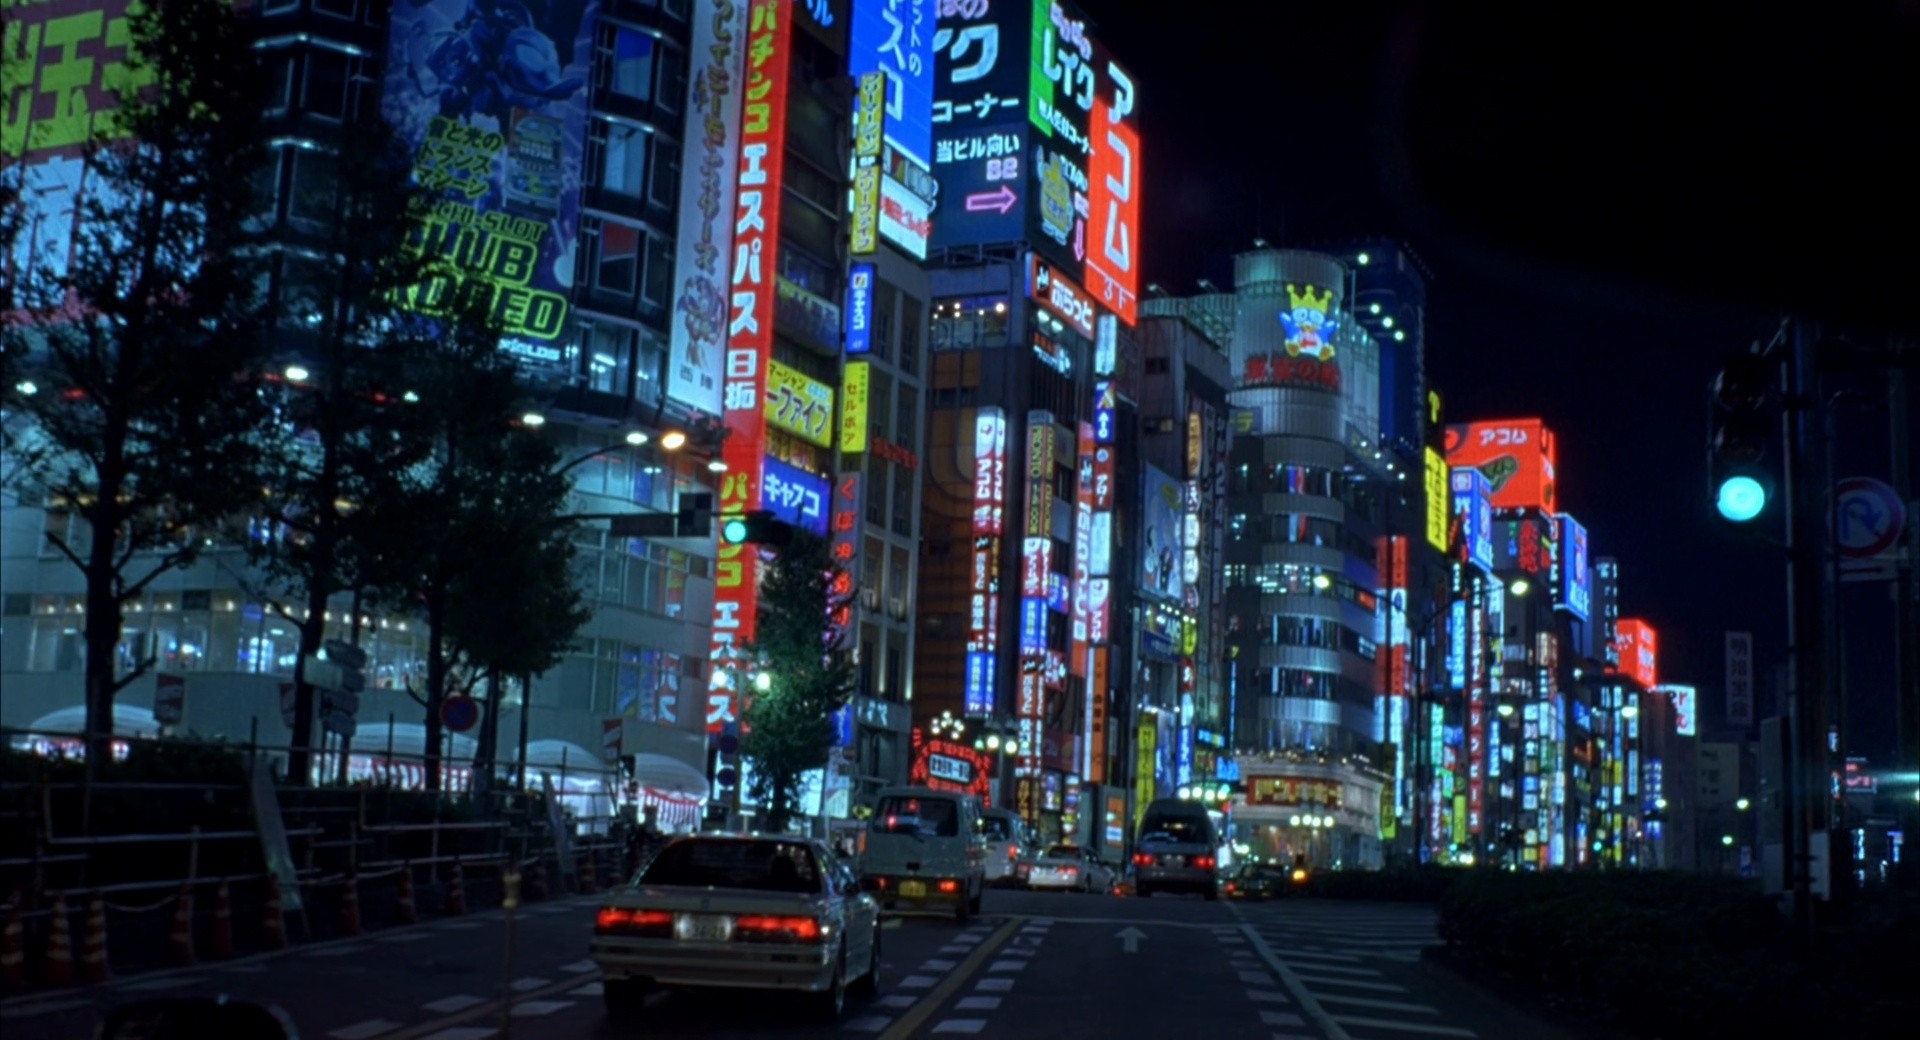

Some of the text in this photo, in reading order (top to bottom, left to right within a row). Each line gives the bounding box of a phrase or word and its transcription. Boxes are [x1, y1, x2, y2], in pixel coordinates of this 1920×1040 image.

[876, 0, 906, 122] スコ
[1042, 26, 1096, 113] レイク
[931, 93, 1020, 123] コーナー
[936, 133, 1021, 163] 当ビル向い
[1106, 60, 1135, 274] アコム
[1103, 274, 1128, 311] 3F
[1478, 428, 1529, 449] アコム
[763, 471, 820, 518] キャスコ
